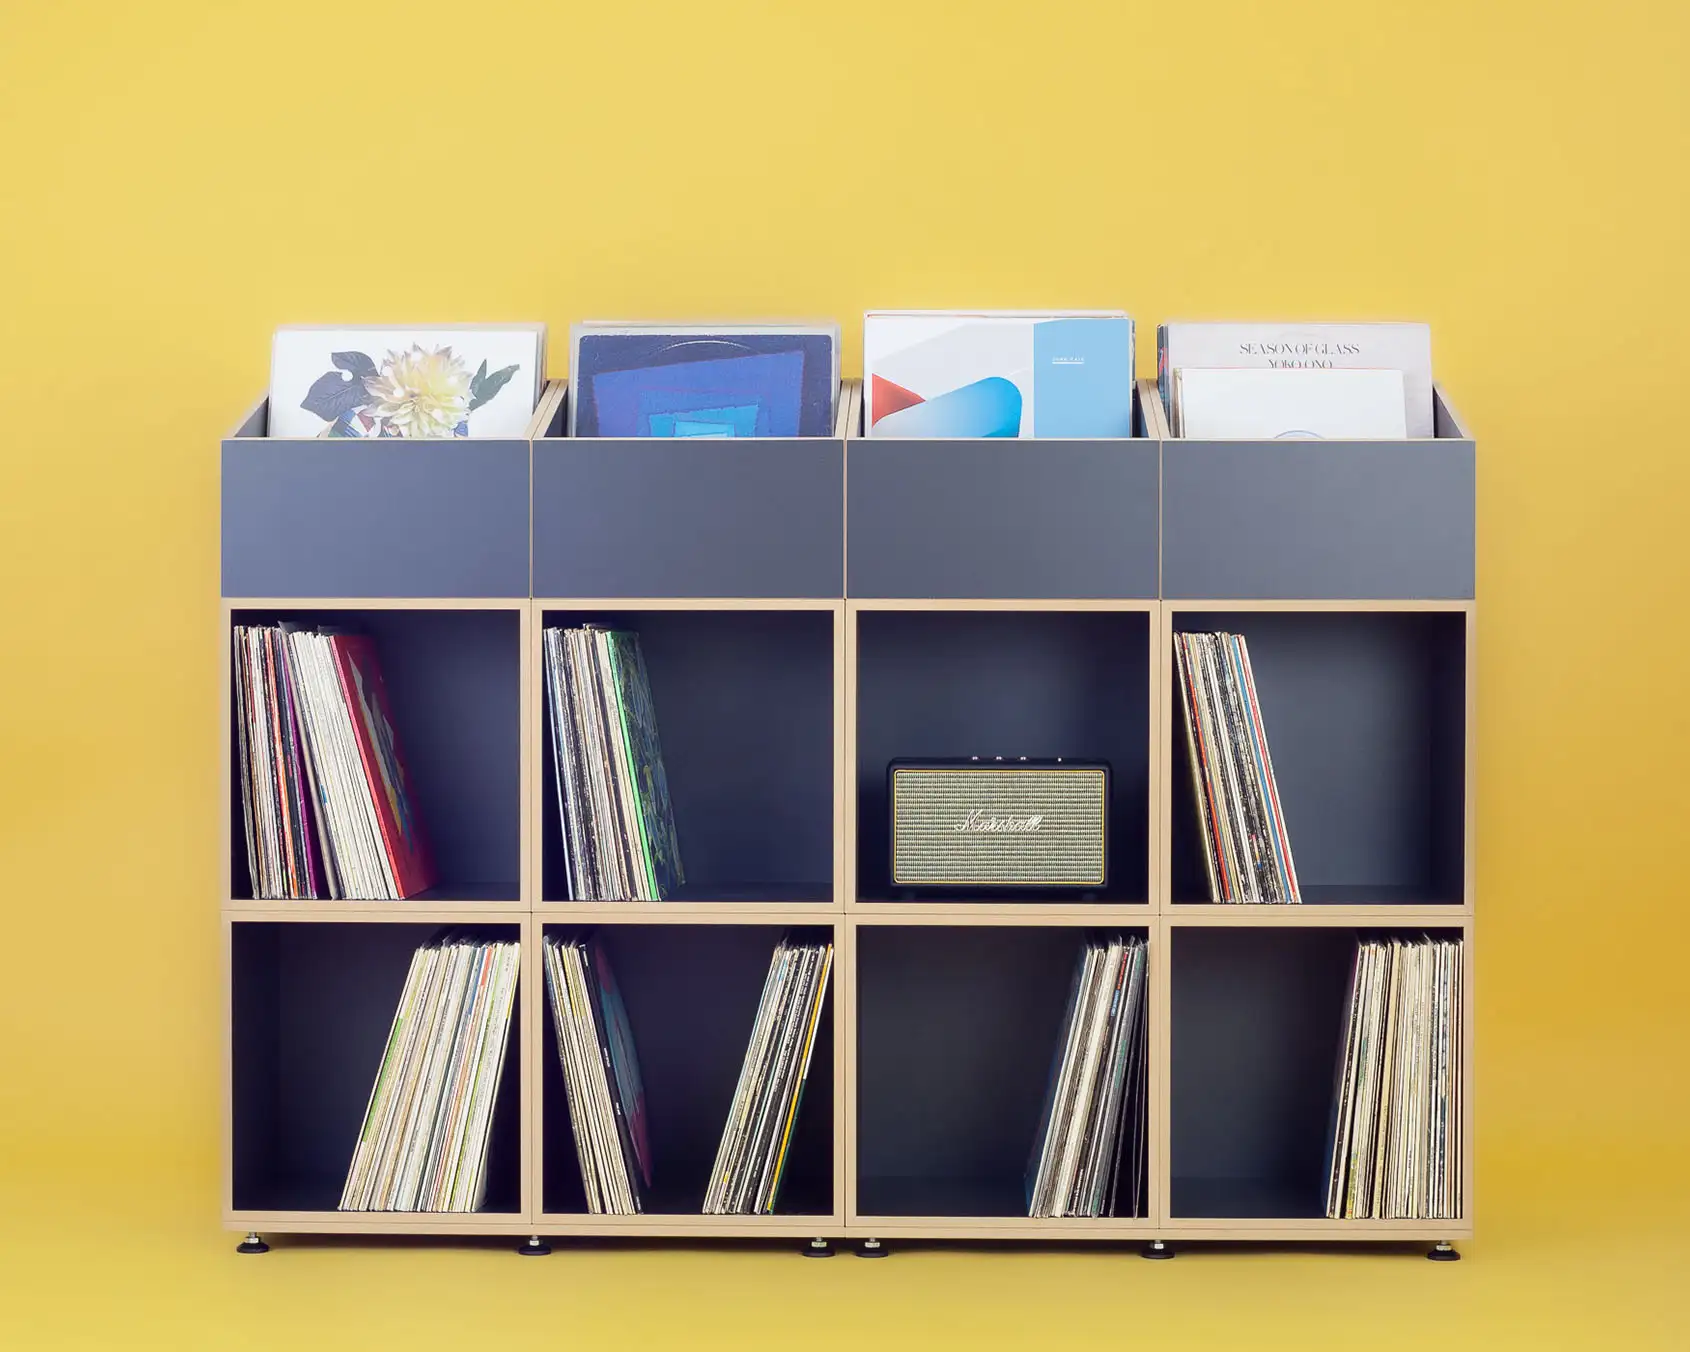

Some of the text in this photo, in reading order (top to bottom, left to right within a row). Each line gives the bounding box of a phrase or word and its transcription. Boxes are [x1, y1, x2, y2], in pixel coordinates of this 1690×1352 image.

[1239, 343, 1361, 355] SEASON OF GLASS
[1268, 359, 1334, 368] YOKO ONO
[954, 809, 1044, 832] Marshall
